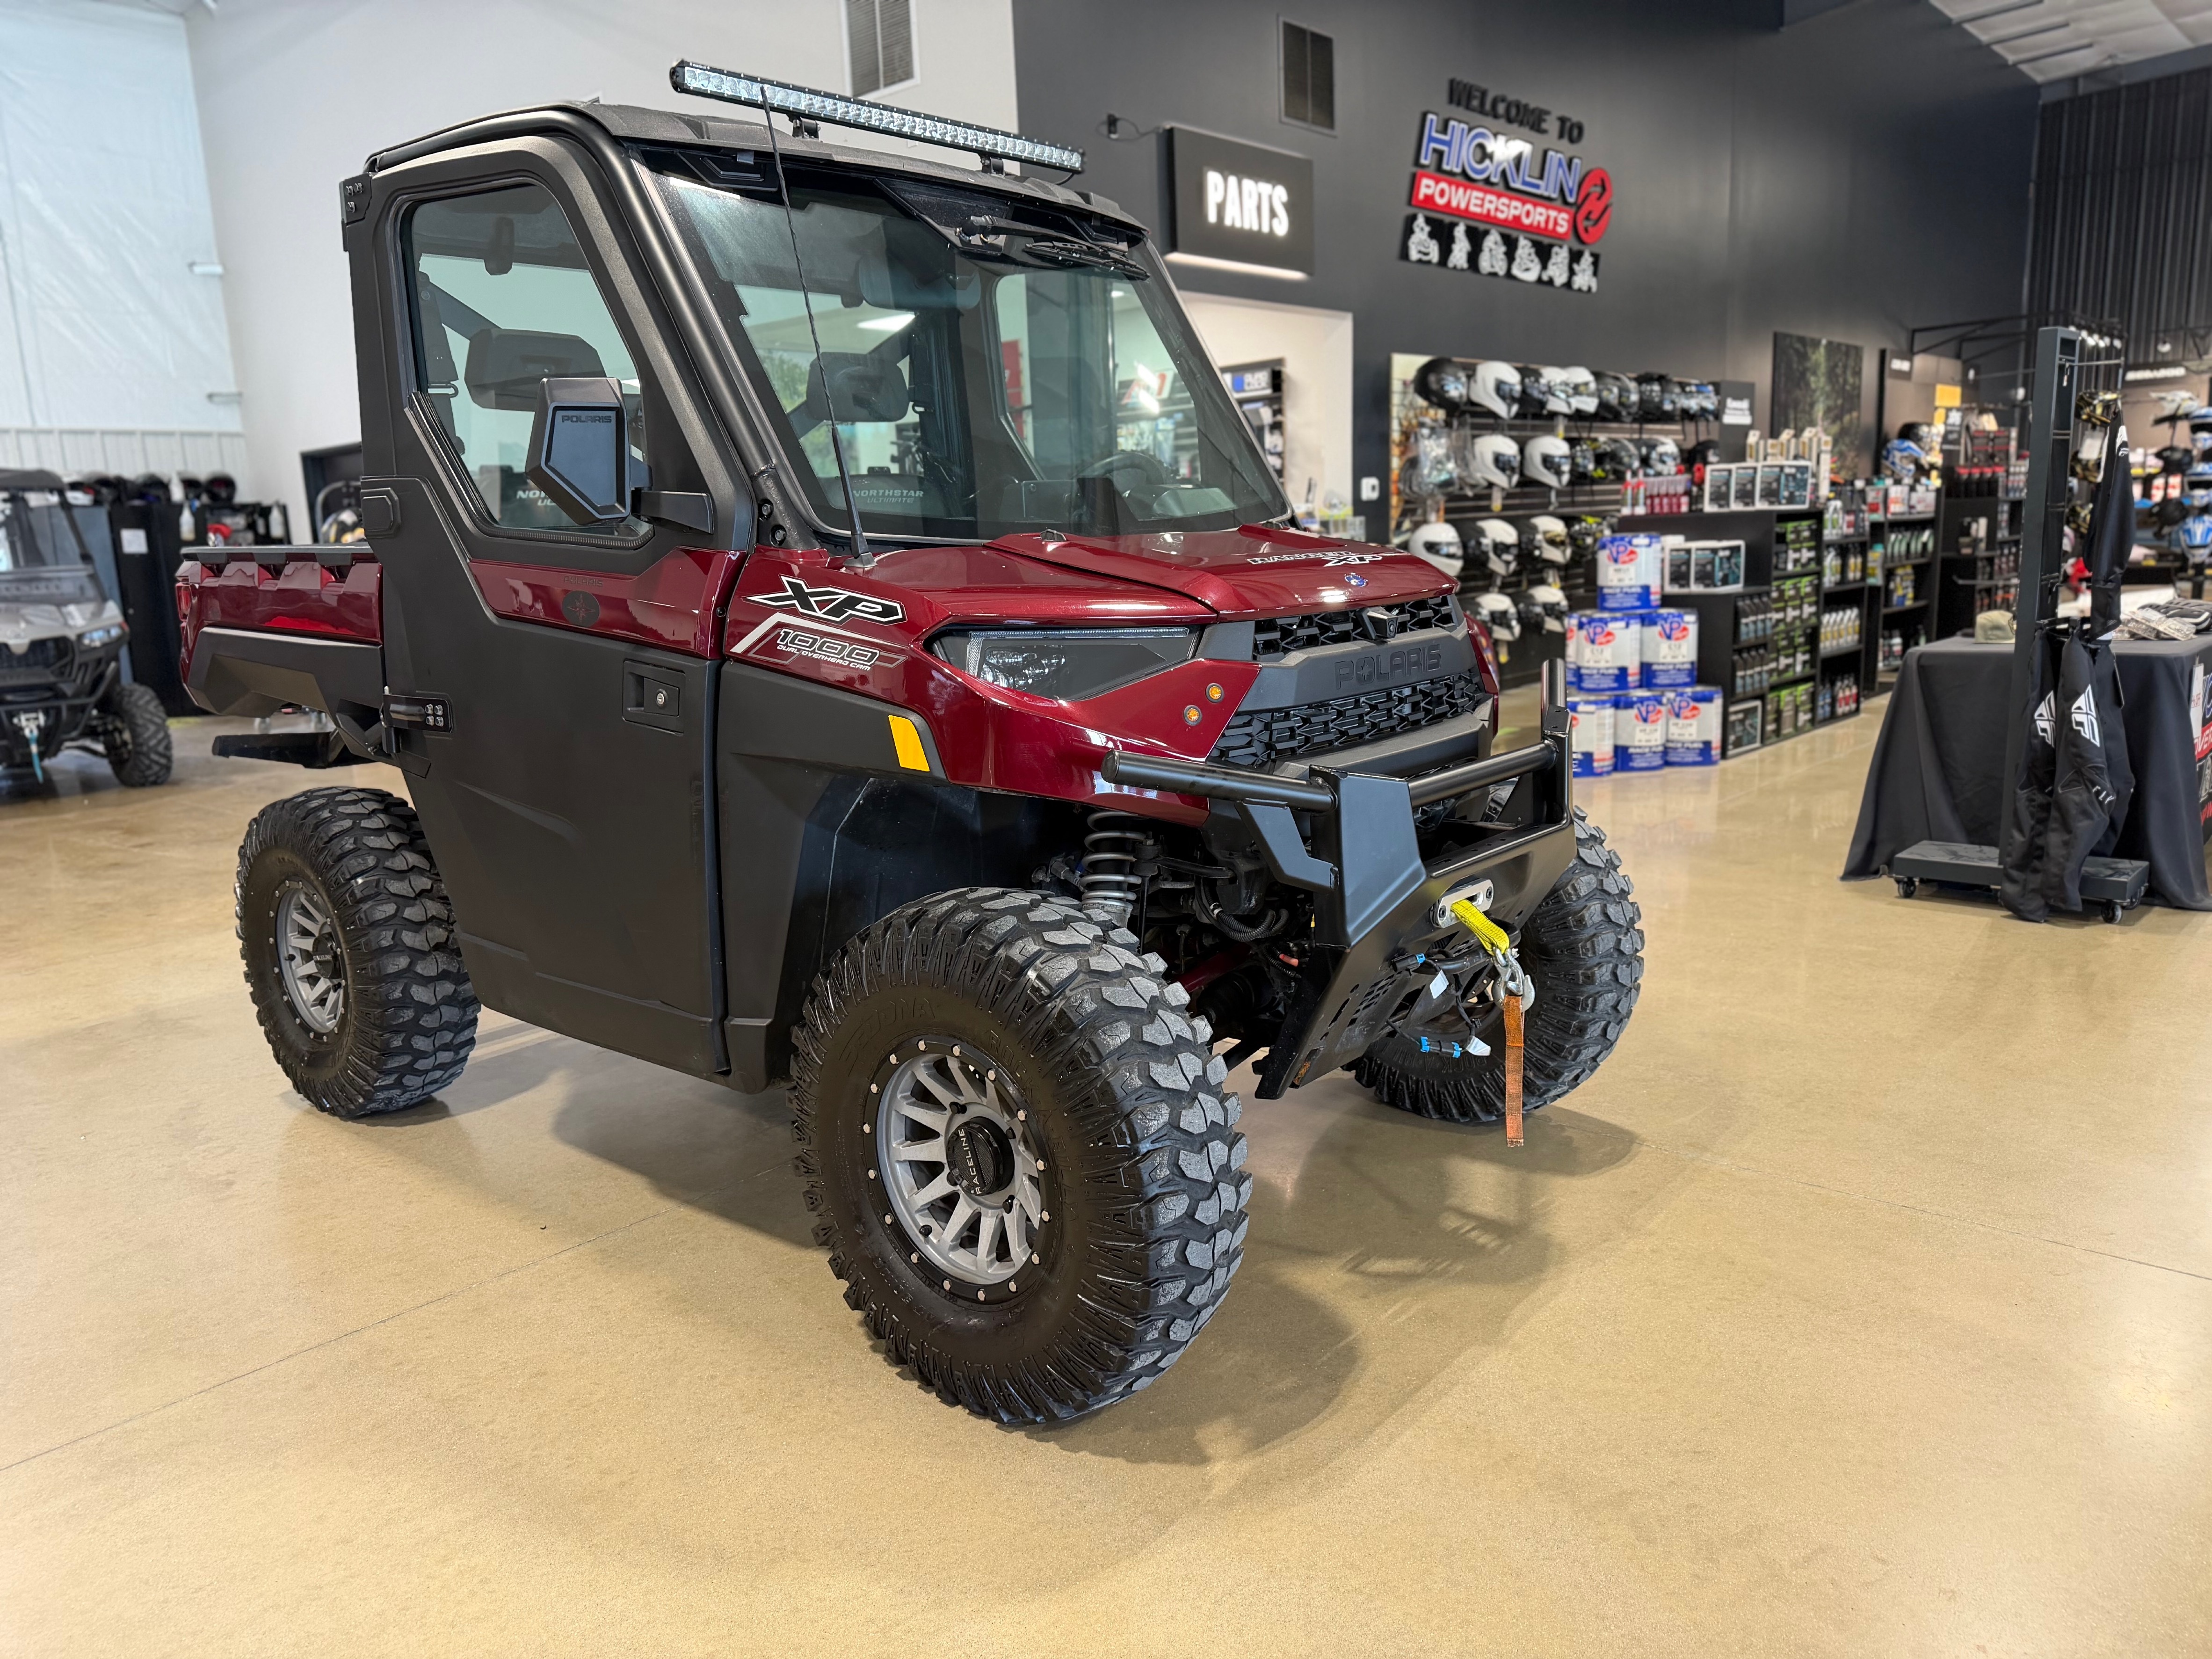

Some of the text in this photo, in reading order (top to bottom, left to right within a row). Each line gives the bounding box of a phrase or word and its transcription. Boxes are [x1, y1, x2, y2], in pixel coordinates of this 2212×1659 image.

[1448, 78, 1584, 144] WELCOME TO
[1418, 112, 1581, 203] HICKLIN
[1206, 170, 1289, 236] PARTS
[1418, 177, 1570, 234] POWERSPORTS
[561, 415, 612, 423] POLARIS
[1247, 551, 1356, 565] RANGER
[1322, 554, 1383, 567] XP
[1606, 540, 1629, 564] VP
[564, 575, 603, 587] POLARIS
[745, 575, 905, 623] XP
[1583, 622, 1606, 646] VP
[1658, 617, 1683, 641] VP
[776, 628, 879, 665] 1000
[776, 645, 871, 671] DUAL OVERHEAD CAM
[1334, 644, 1442, 690] POLARIS
[1635, 700, 1658, 724] VP
[1668, 695, 1692, 719] VP
[2092, 785, 2115, 804] FLY
[958, 1128, 982, 1194] RACELINE
